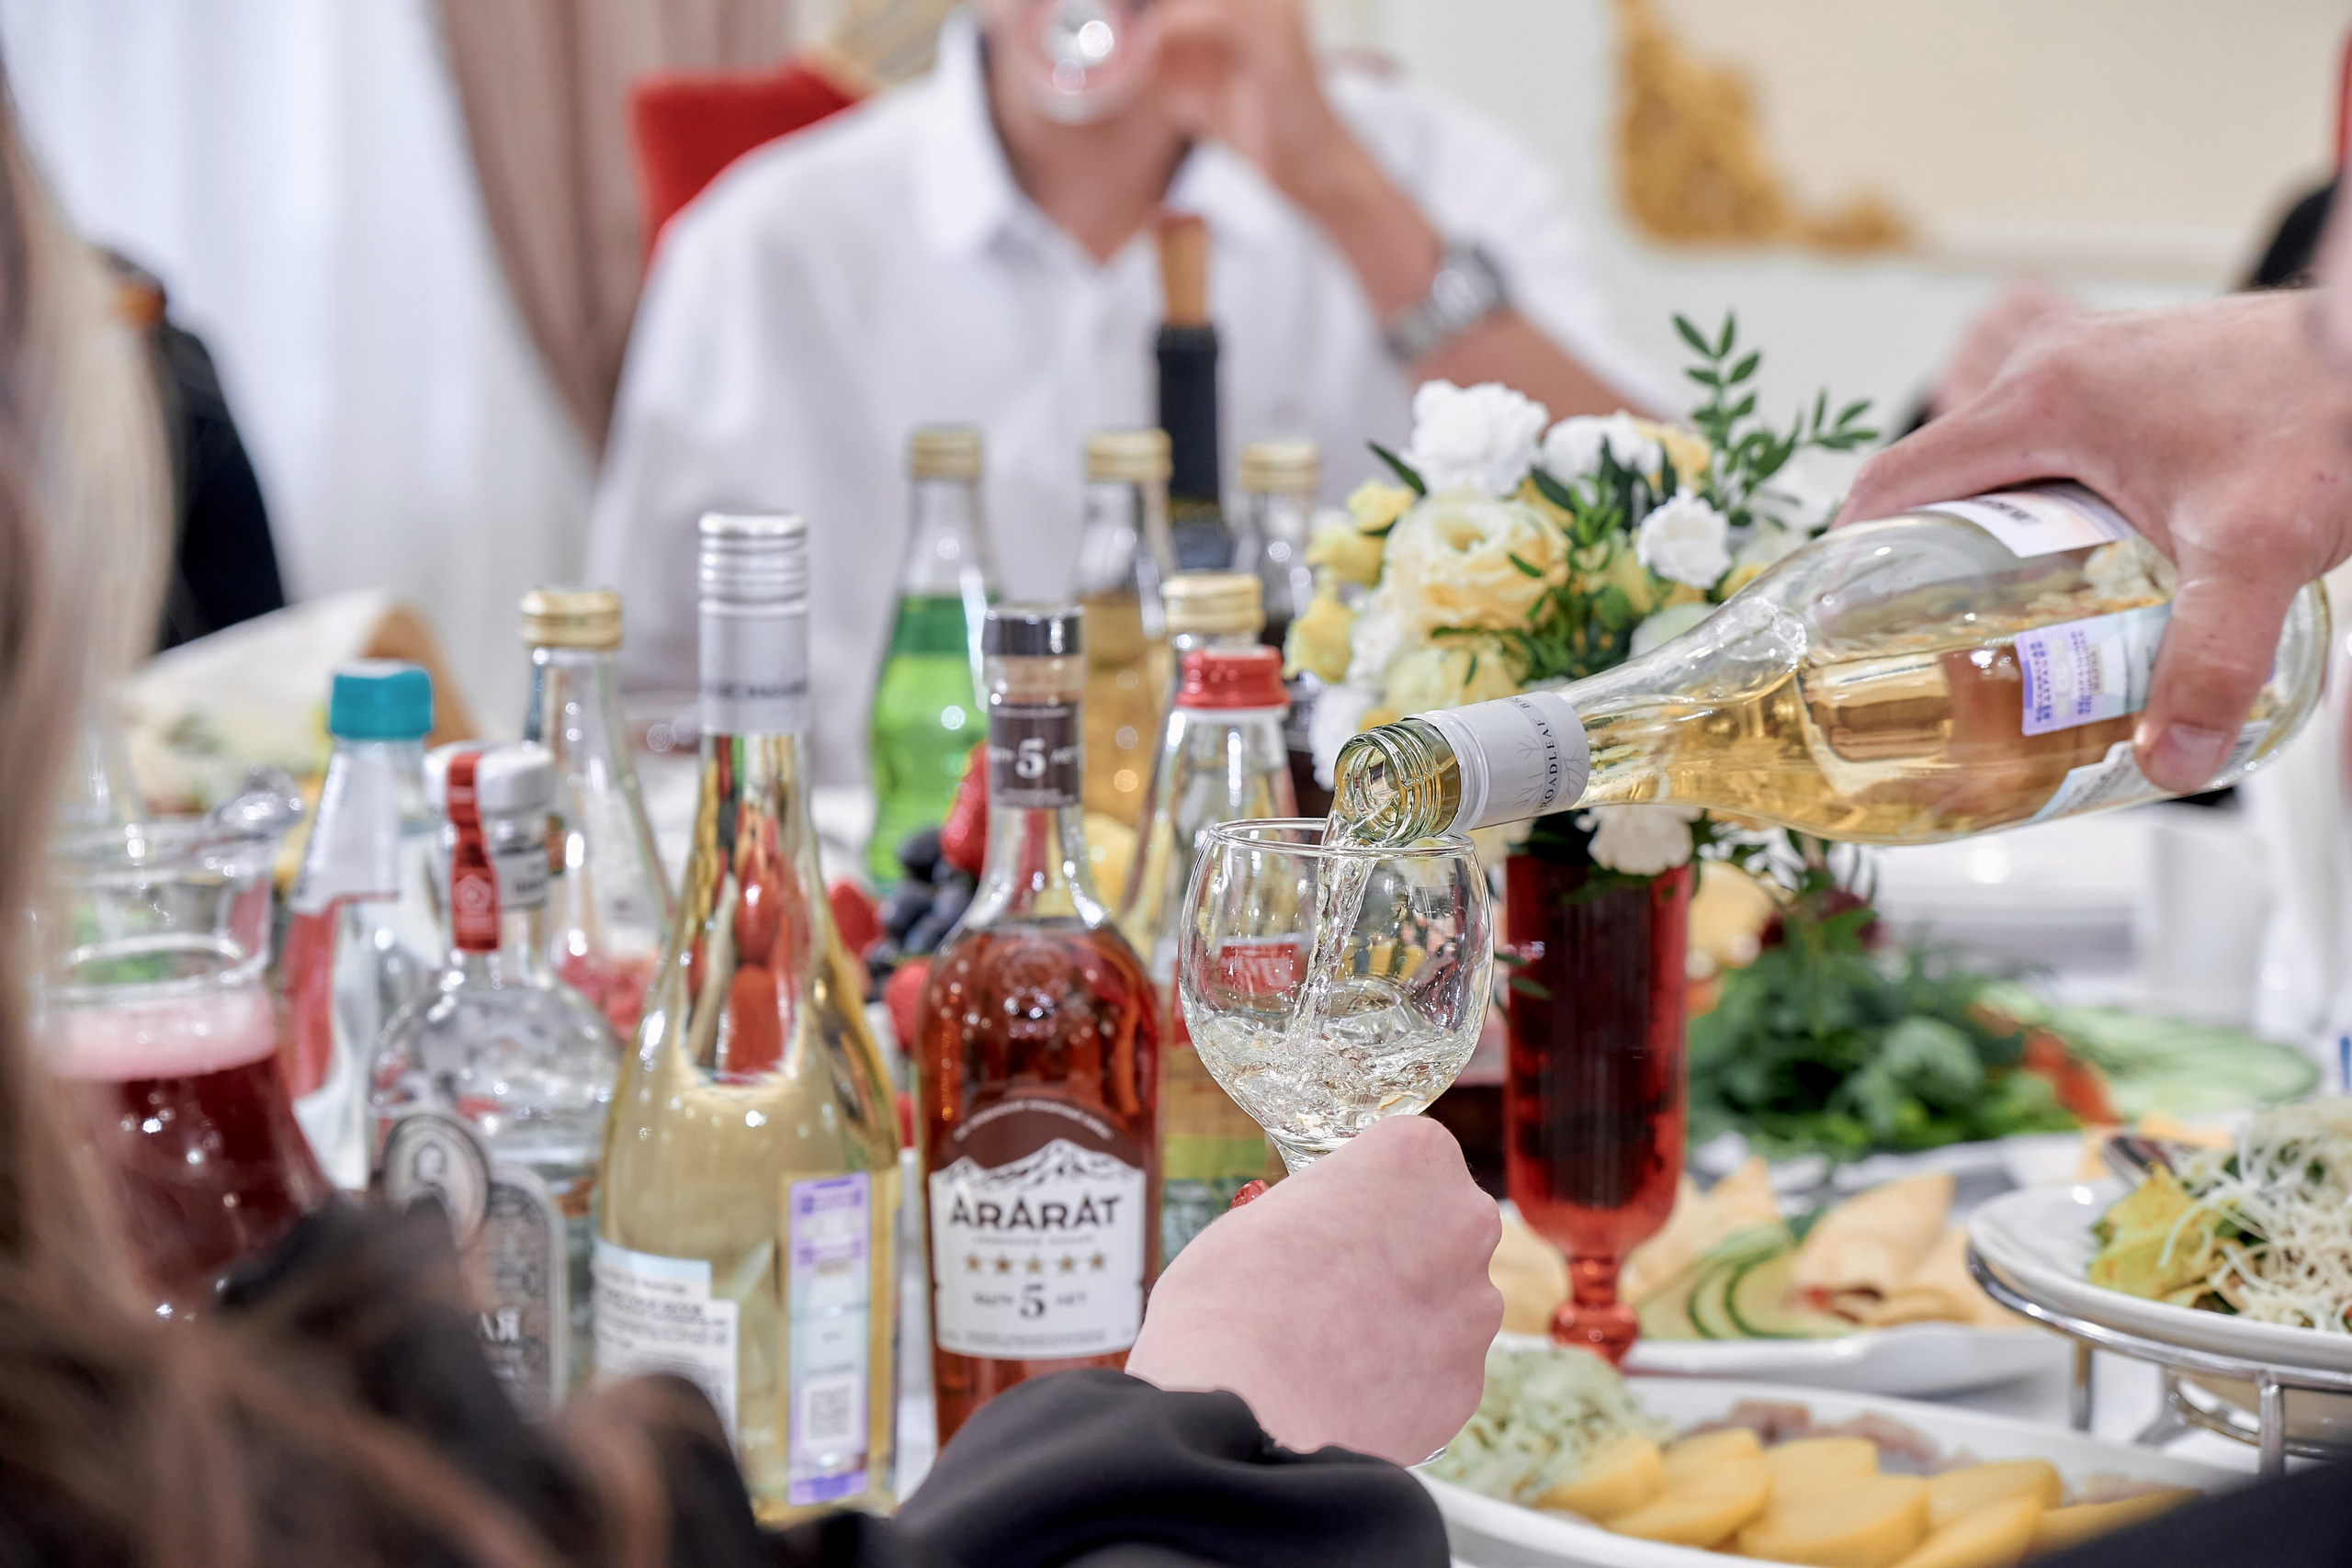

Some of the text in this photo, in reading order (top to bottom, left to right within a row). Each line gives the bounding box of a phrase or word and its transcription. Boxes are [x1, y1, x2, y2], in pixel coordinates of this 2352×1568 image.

[1015, 738, 1046, 779] 5
[950, 1193, 1121, 1230] ARARAT
[1020, 1283, 1045, 1319] 5
